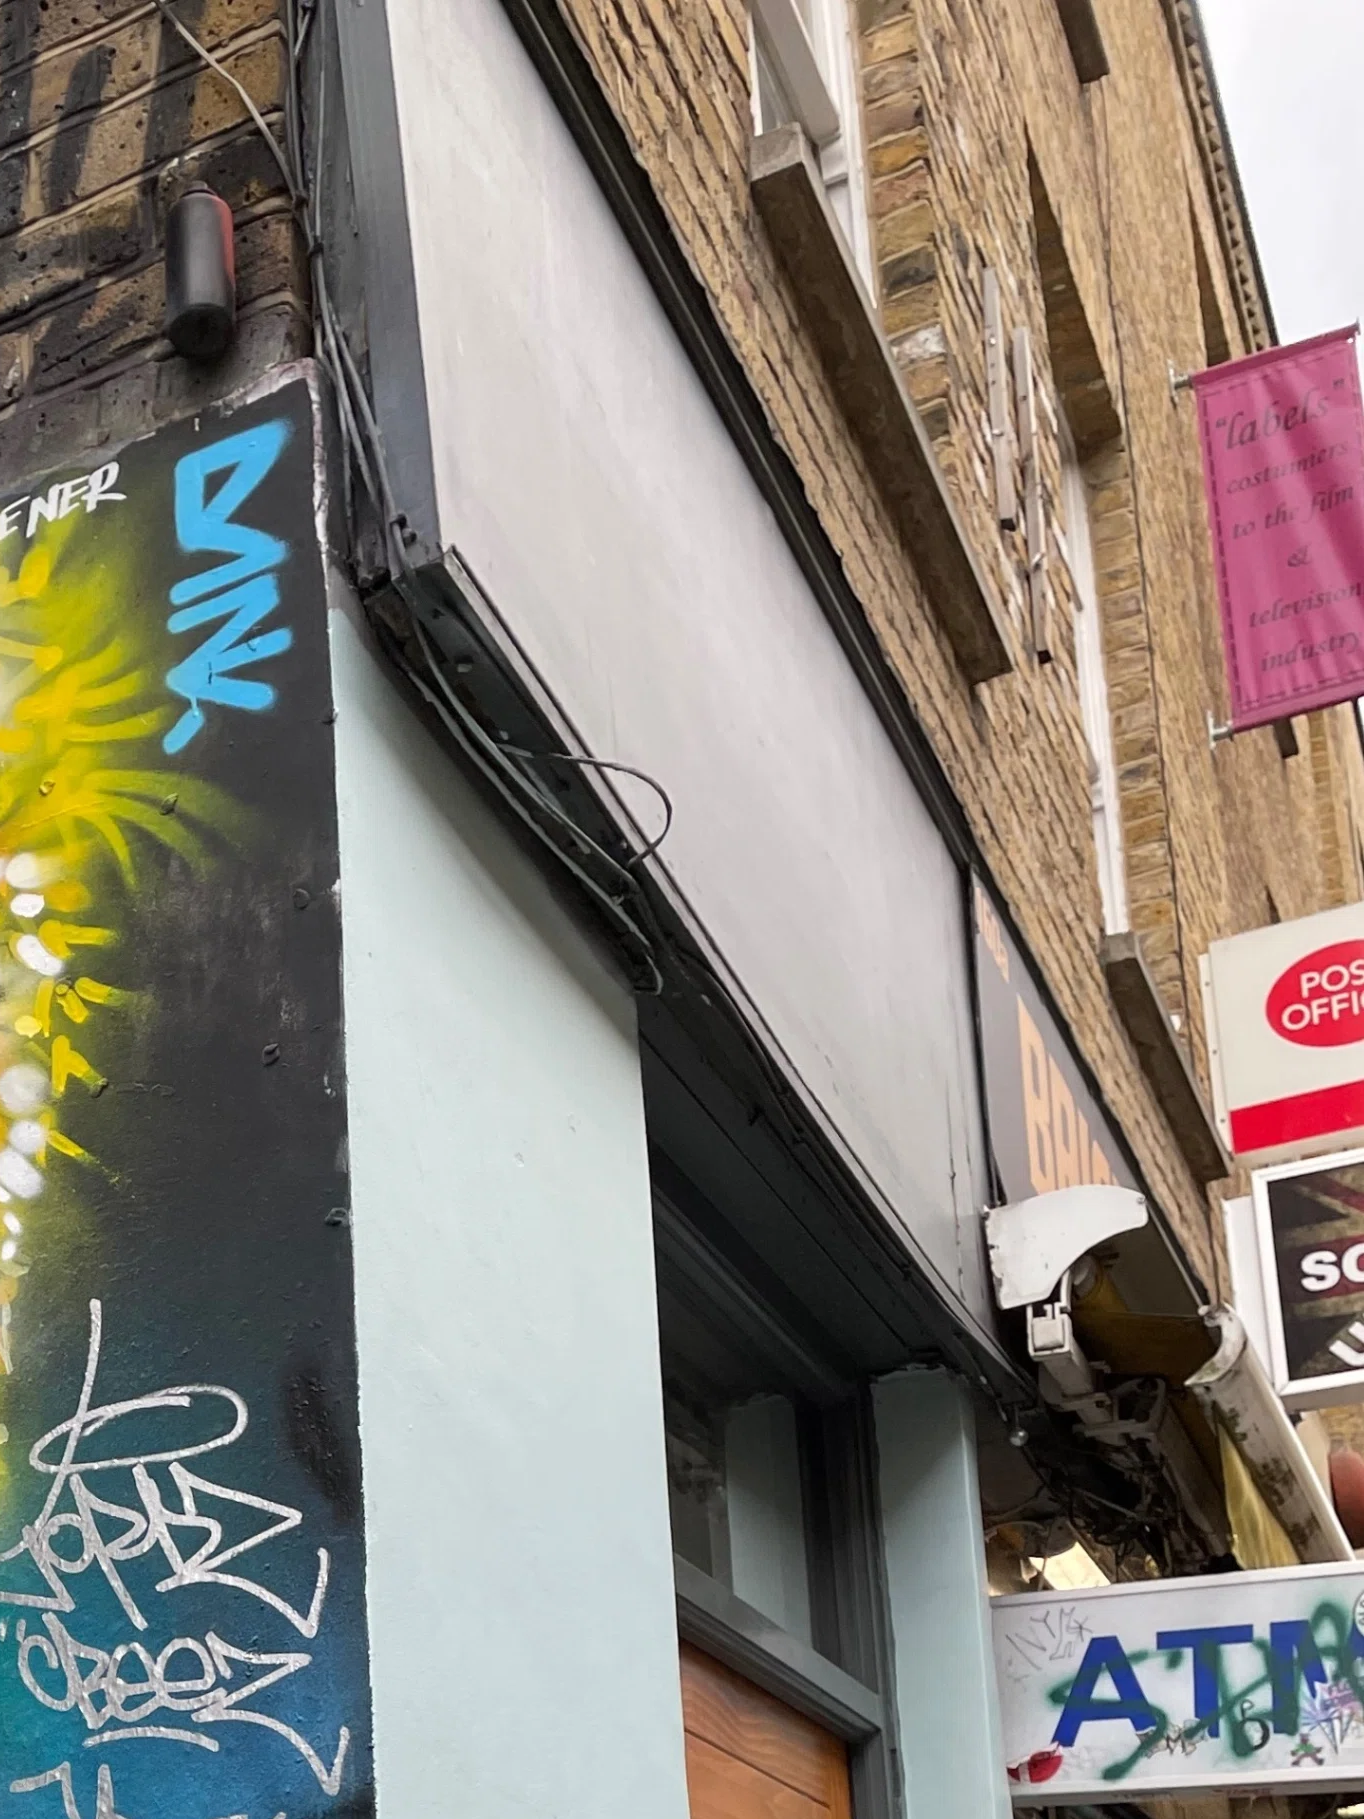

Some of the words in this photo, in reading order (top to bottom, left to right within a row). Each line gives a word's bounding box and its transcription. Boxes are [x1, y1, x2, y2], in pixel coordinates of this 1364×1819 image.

[1233, 521, 1256, 540] to
[1249, 581, 1363, 629] television
[1261, 631, 1360, 672] industry
